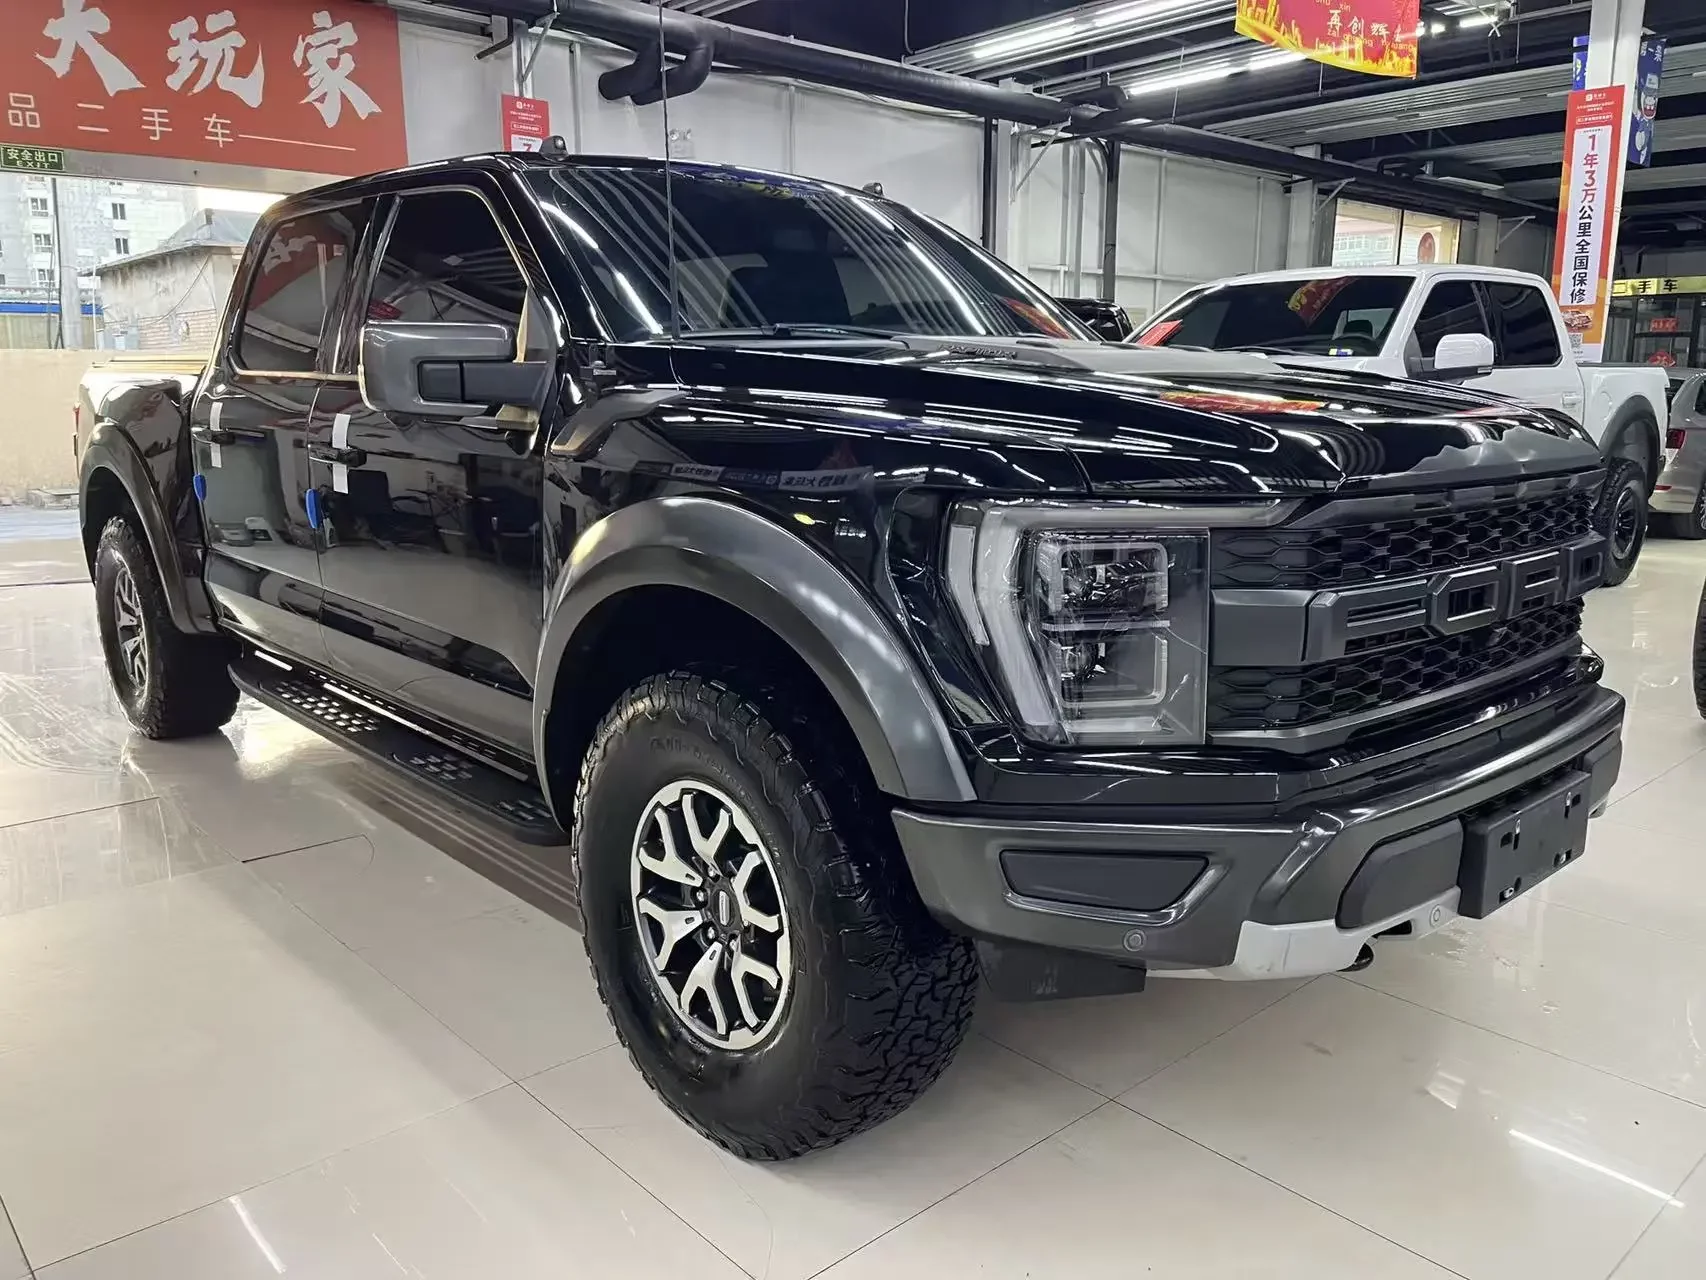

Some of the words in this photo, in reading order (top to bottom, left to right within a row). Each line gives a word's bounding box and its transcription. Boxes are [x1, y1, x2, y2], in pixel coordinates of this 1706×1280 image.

[34, 0, 382, 128] 大玩家
[7, 92, 235, 148] 品二手车
[7, 148, 58, 162] 安全出口
[16, 160, 50, 169] EXIT
[1570, 134, 1599, 304] 1年3万公里全国保修
[1613, 279, 1678, 295] 二手车
[1308, 540, 1607, 664] FORD
